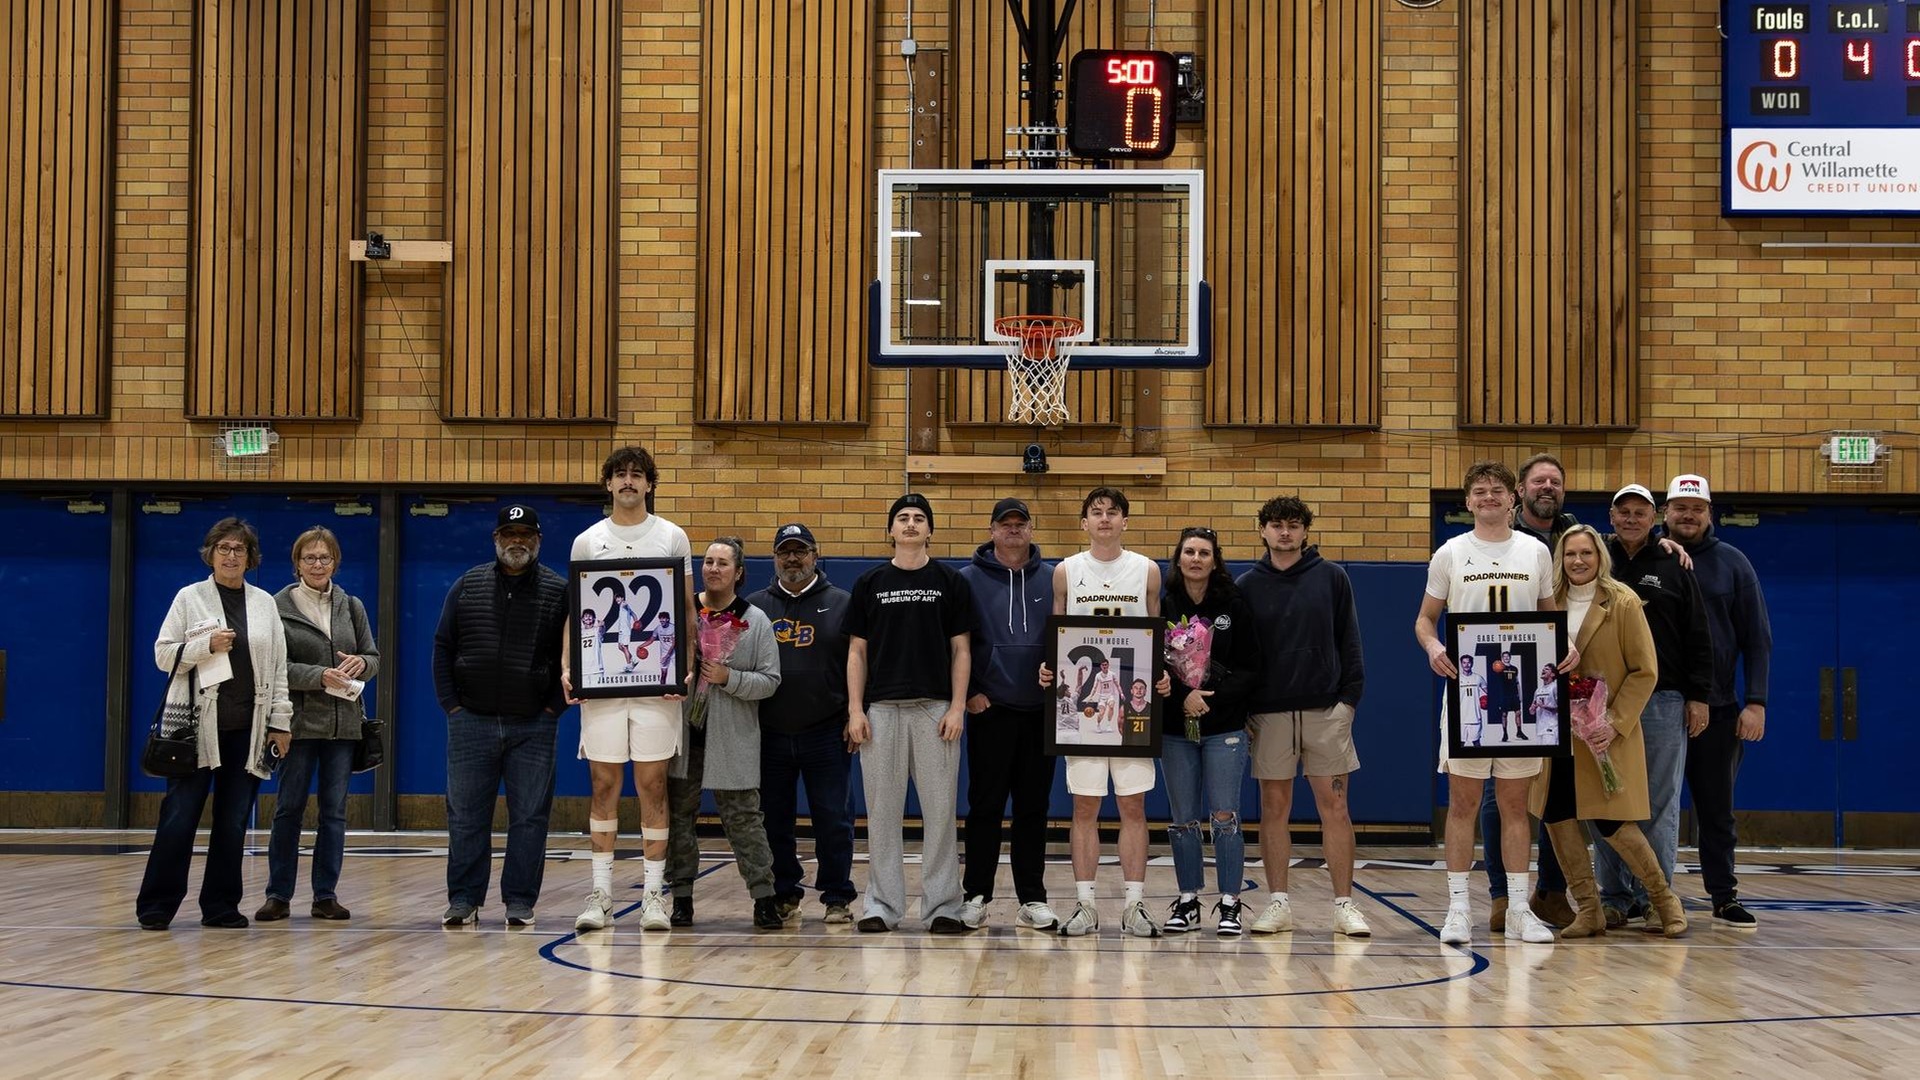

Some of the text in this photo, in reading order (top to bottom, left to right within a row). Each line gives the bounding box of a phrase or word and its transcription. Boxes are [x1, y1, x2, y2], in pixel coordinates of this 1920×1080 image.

[1756, 8, 1880, 30] fouls t.o.l.
[1774, 40, 1796, 78] 0
[1847, 41, 1870, 75] 4
[1108, 59, 1155, 84] 5:00
[1761, 92, 1800, 109] won
[1125, 87, 1162, 149] 0
[1787, 140, 1851, 157] Central
[1802, 162, 1898, 178] Willamette
[1807, 183, 1918, 193] CREDIT UNION
[232, 430, 262, 454] EXIT
[1839, 438, 1869, 461] EXIT
[510, 507, 524, 520] D
[1463, 572, 1530, 583] ROADRUNNERS
[876, 589, 942, 599] THE METROPOLITAN
[881, 595, 911, 604] MUSEUM
[1076, 594, 1139, 604] ROADRUNNERS
[592, 574, 662, 643] 22
[583, 639, 593, 649] 22
[597, 675, 628, 684] JACKSON
[1067, 645, 1135, 712] 21
[1466, 687, 1473, 697] 11
[1133, 721, 1144, 733] 21
